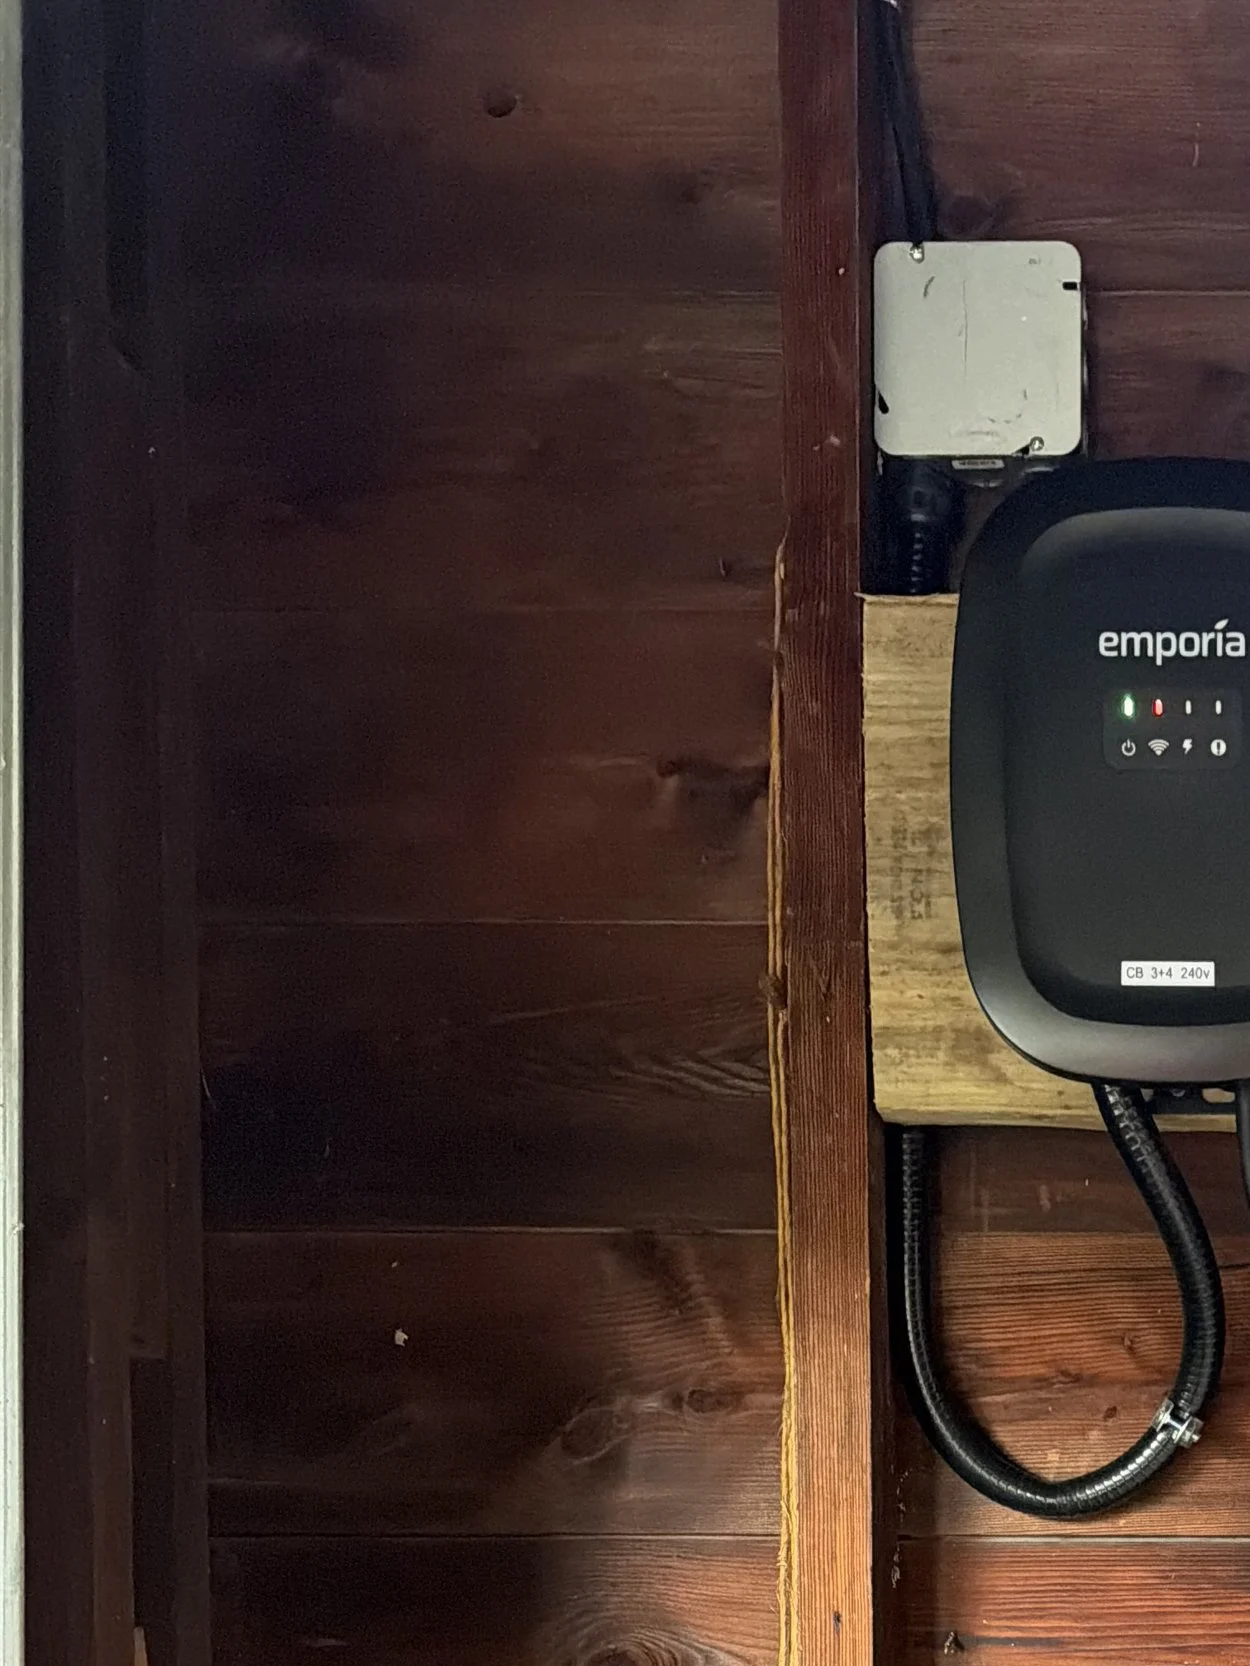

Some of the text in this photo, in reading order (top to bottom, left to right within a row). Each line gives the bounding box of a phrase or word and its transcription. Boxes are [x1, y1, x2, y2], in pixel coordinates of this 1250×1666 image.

[1126, 966, 1210, 979] CB 3+4 240v
